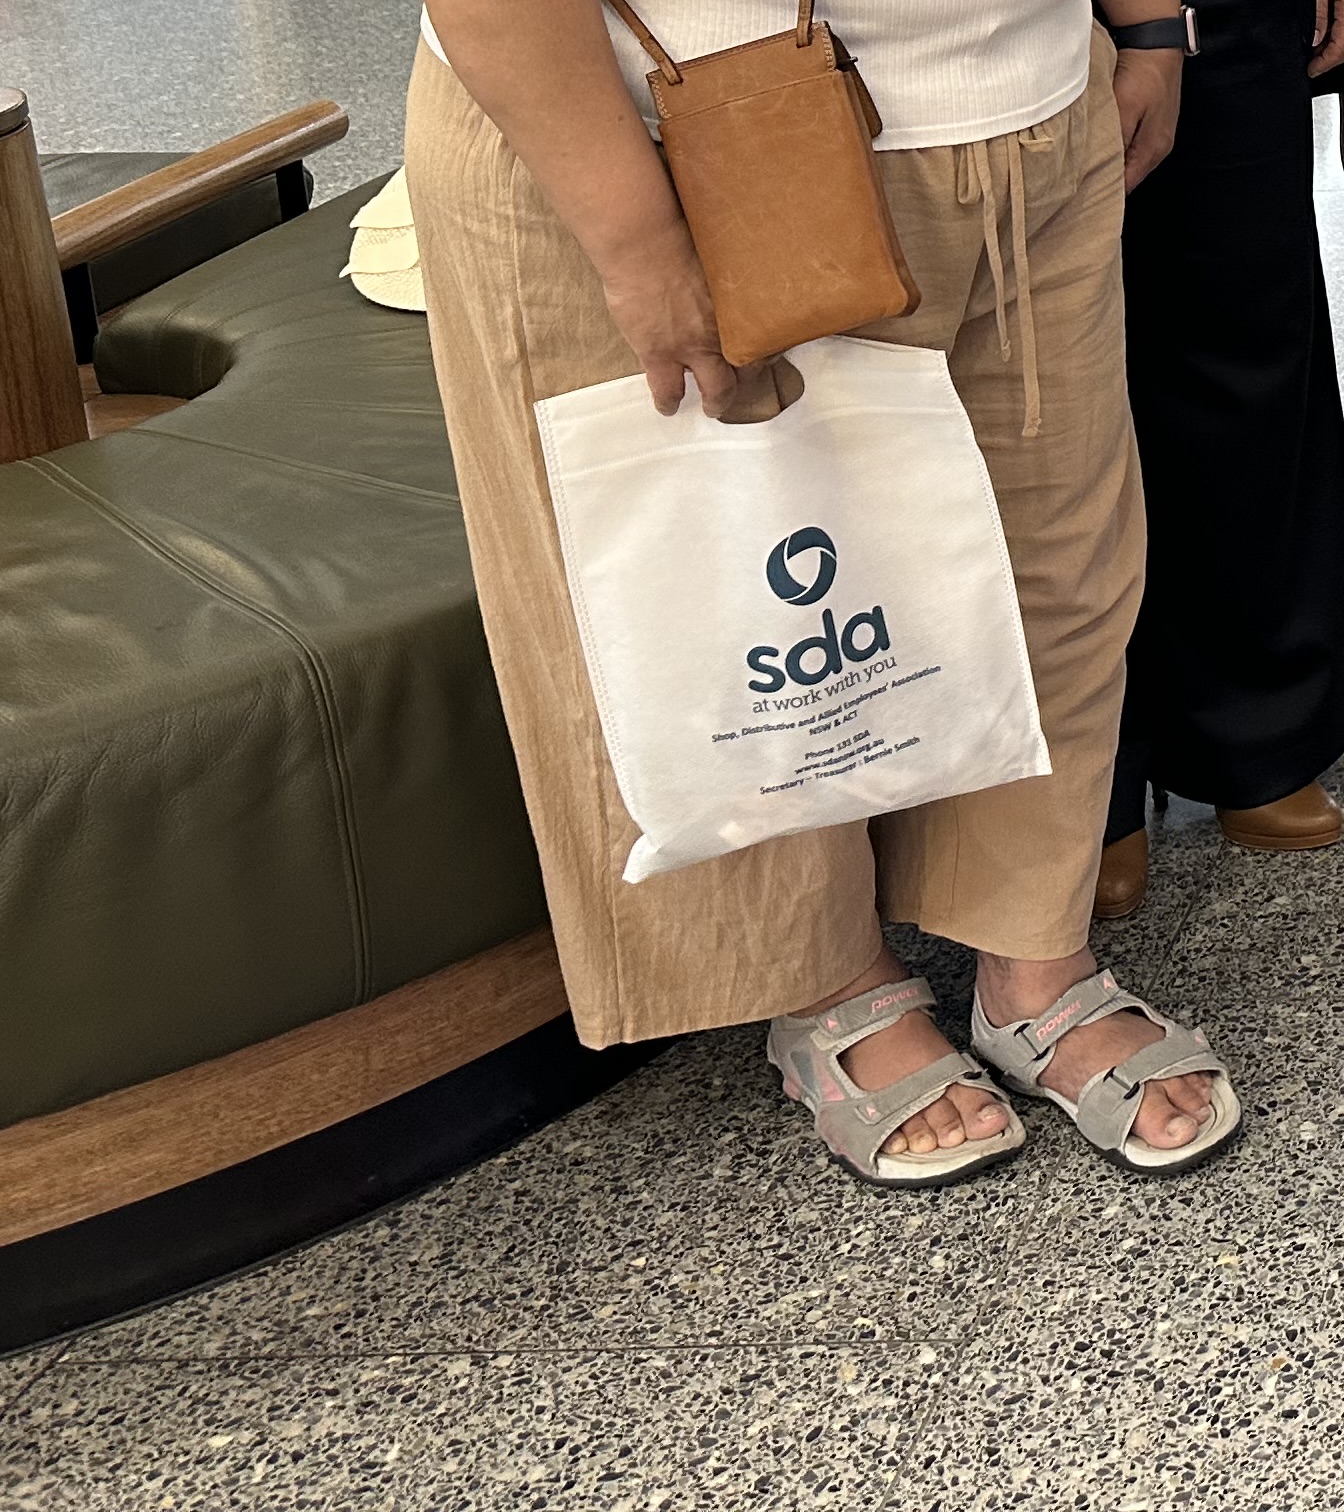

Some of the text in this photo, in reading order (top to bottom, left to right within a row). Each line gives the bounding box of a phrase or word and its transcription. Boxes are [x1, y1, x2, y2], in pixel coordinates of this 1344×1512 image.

[747, 605, 891, 693] sda
[711, 731, 740, 743] Shop,
[741, 721, 796, 737] Distributive
[798, 715, 816, 727] and
[891, 665, 942, 689] Association
[752, 655, 898, 714] at work with you
[804, 746, 835, 760] Phone
[852, 729, 871, 744] SDA
[809, 722, 832, 736] NSW
[842, 709, 858, 724] ACT
[760, 778, 805, 794] Secretary
[815, 761, 857, 779] Treasurer
[863, 746, 893, 764] Bernie
[894, 736, 921, 752] Smith
